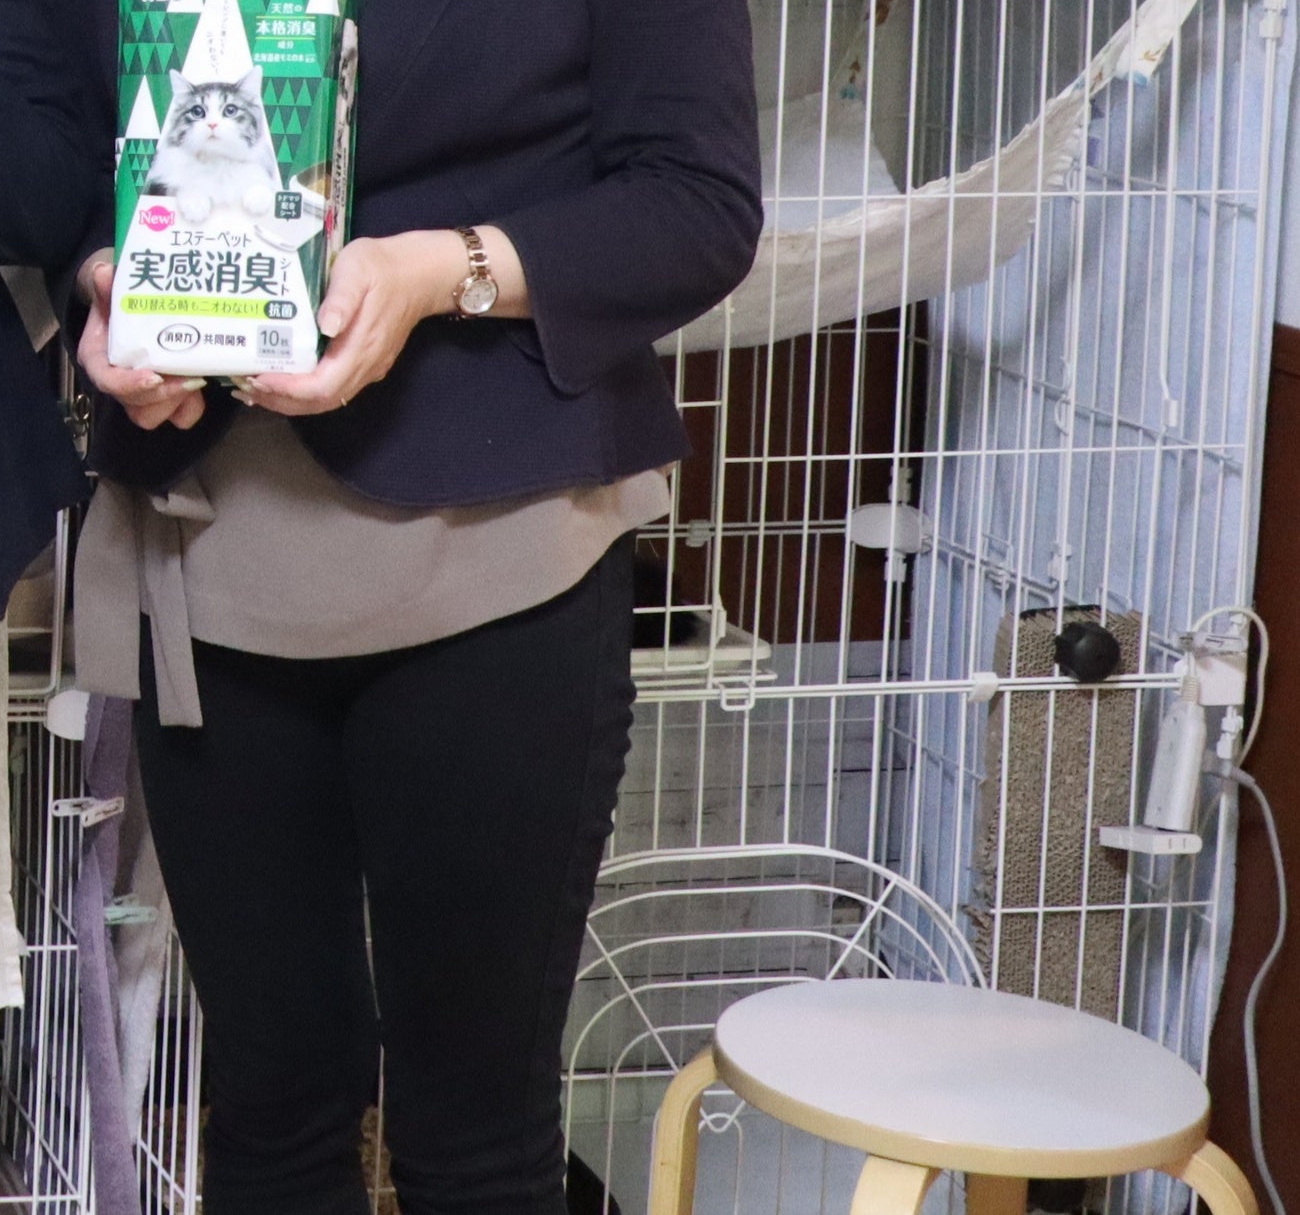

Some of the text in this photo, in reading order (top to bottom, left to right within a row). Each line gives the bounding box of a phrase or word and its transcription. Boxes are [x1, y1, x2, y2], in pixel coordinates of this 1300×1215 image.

[255, 19, 317, 36] 本格消臭
[139, 210, 175, 225] New!
[170, 231, 252, 248] エステーペット
[128, 249, 279, 296] 実感消臭
[280, 257, 292, 297] シート
[127, 298, 259, 315] 取り替える時もニオわない!
[268, 303, 294, 318] 抗菌
[164, 332, 246, 347] 消臭力 共同開発
